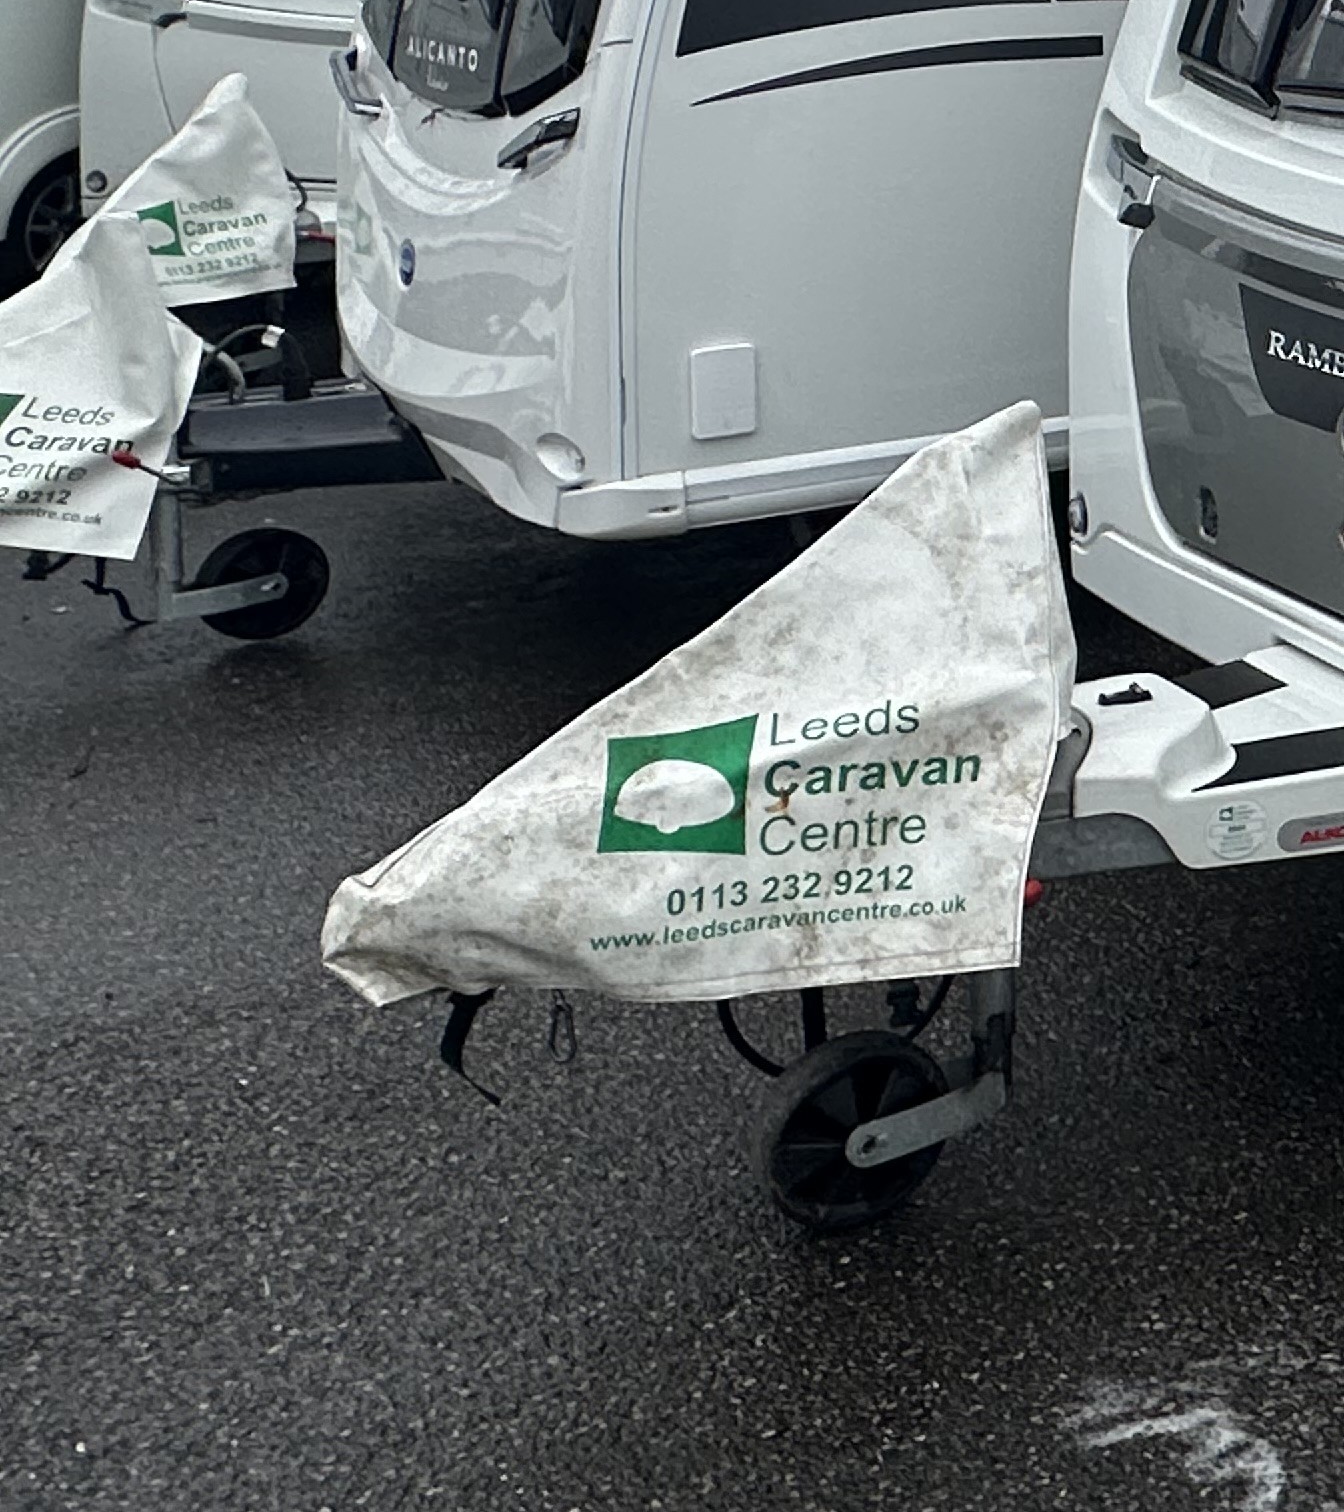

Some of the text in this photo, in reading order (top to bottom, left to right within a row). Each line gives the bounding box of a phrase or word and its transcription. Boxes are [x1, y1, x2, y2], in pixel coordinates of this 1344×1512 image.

[405, 35, 478, 72] ALICANTO
[177, 194, 234, 215] Leeds
[183, 212, 268, 236] Caravan
[188, 236, 256, 256] Centre
[21, 396, 116, 427] Leeds
[5, 426, 134, 456] Caravan
[15, 488, 72, 505] 9212
[770, 699, 920, 746] Leeds
[764, 754, 982, 799] Caravan
[760, 810, 926, 856] Centre
[666, 864, 915, 916] 0113 232 9212
[589, 894, 968, 951] www.leedscaravancentre.co.uk
